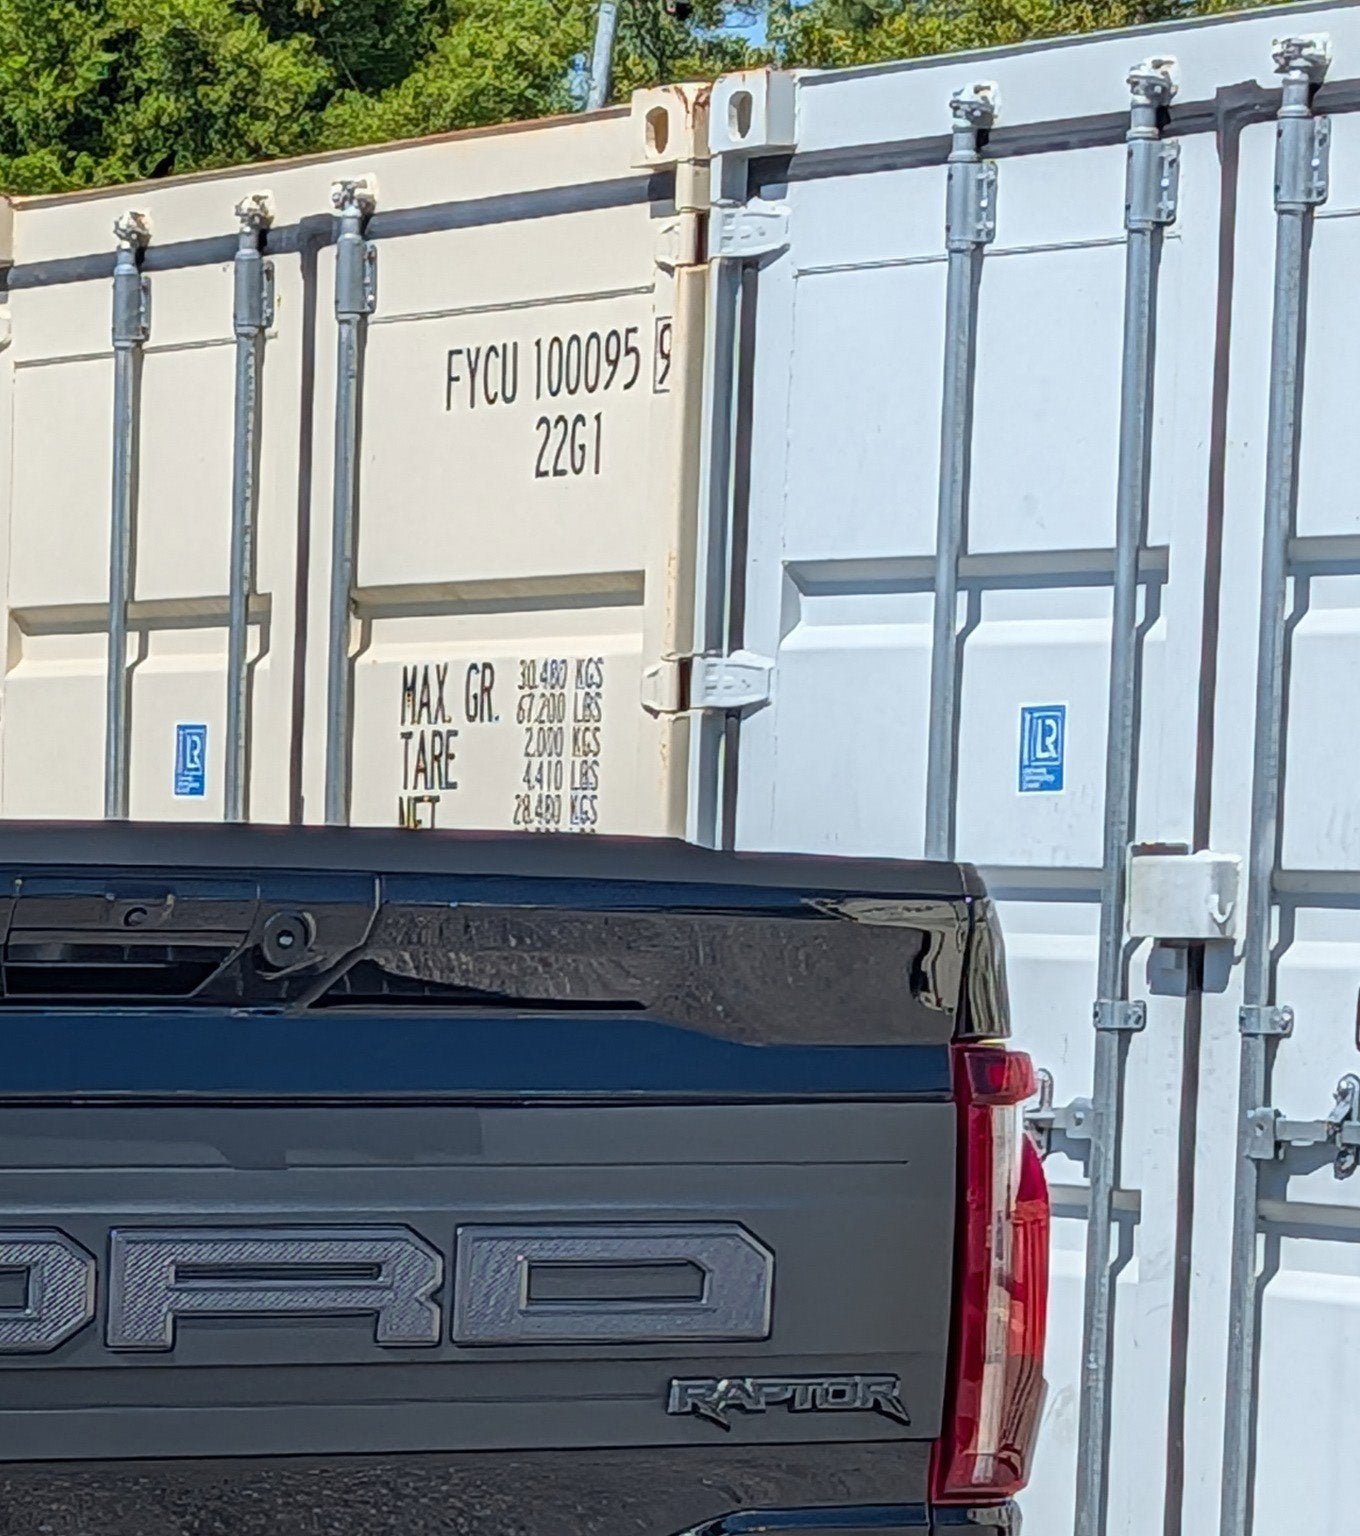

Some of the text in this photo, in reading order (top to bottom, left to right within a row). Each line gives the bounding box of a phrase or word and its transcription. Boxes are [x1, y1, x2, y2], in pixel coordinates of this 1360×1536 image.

[445, 341, 519, 411] FYCU
[534, 326, 640, 400] 100095
[534, 411, 602, 479] 22G1
[465, 661, 499, 723] GR.
[574, 657, 605, 690] KGS
[573, 691, 603, 723] LBS
[400, 729, 459, 790] TARE
[571, 726, 601, 758] KGS
[570, 759, 600, 791] LBS
[667, 1374, 911, 1431] RAPTOR
